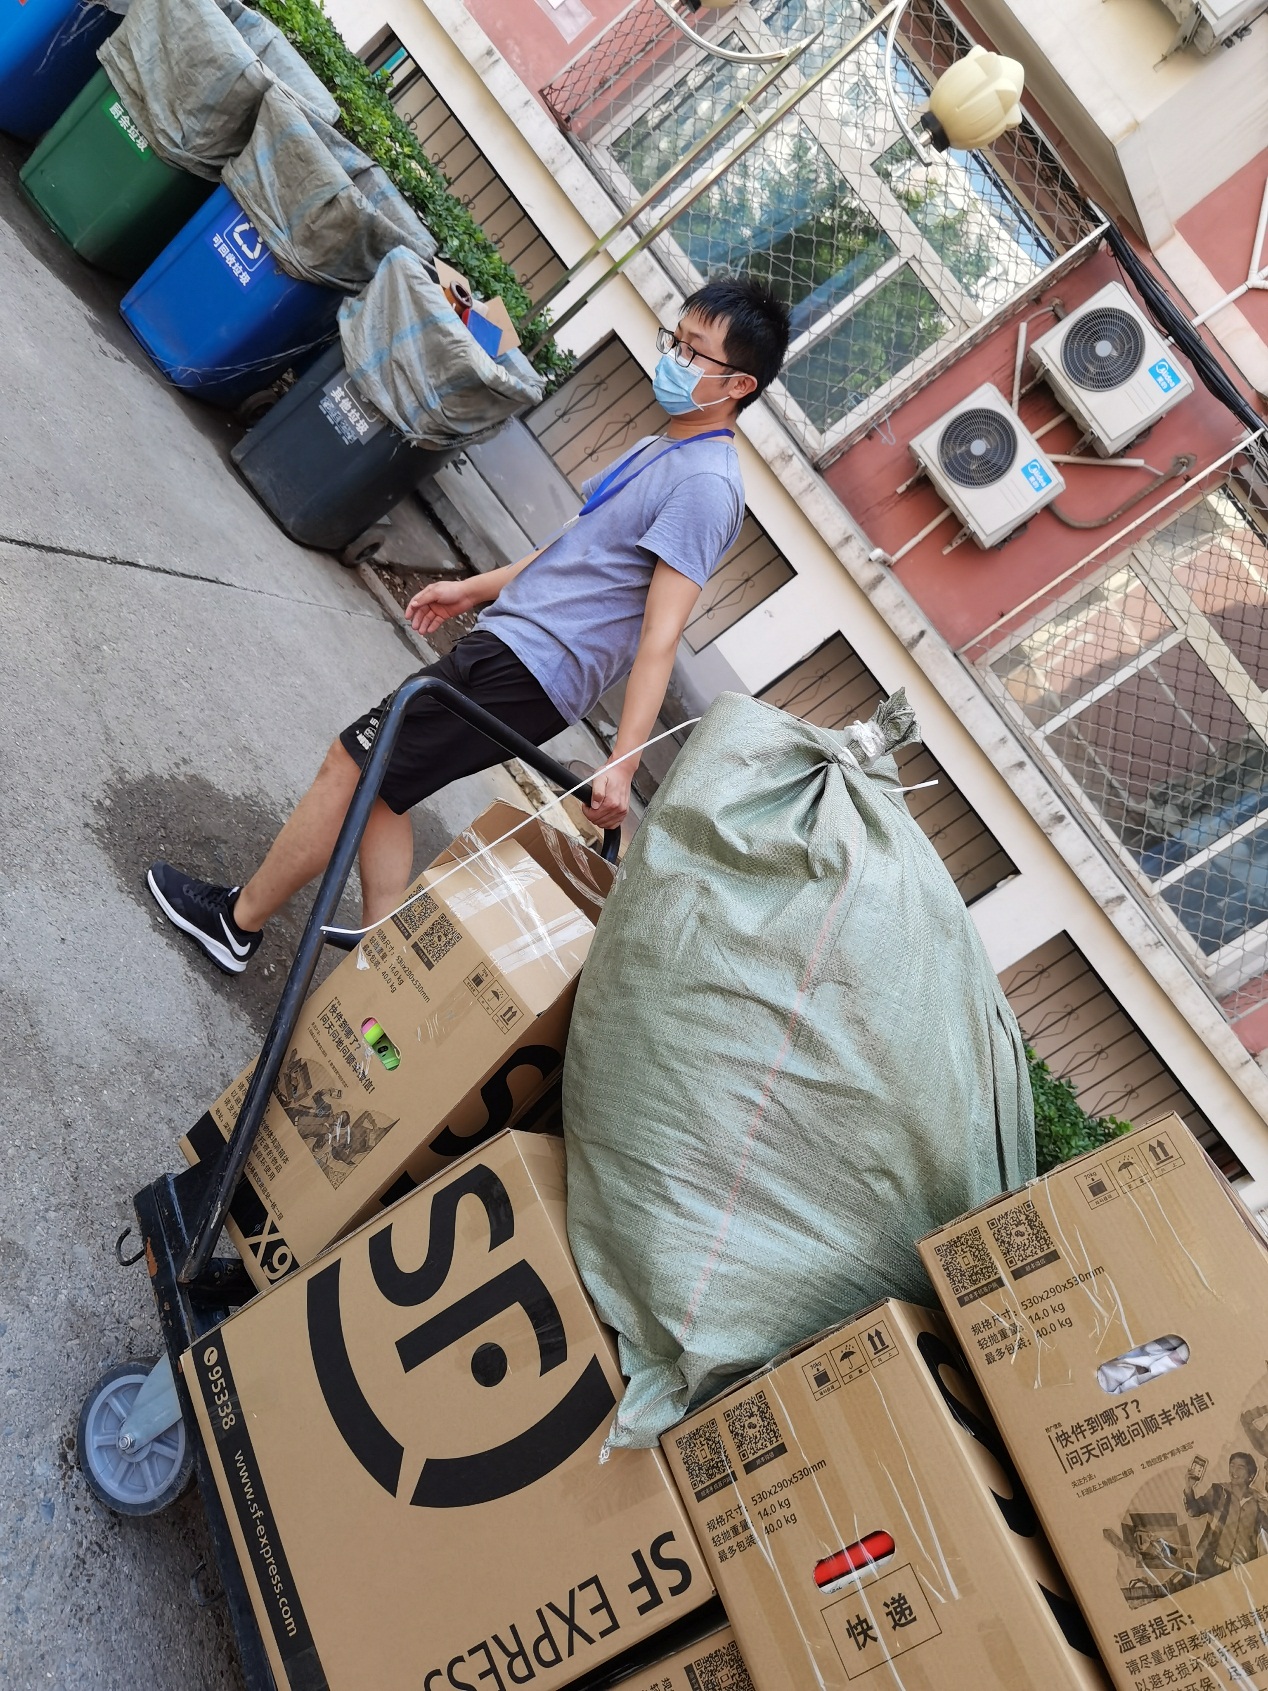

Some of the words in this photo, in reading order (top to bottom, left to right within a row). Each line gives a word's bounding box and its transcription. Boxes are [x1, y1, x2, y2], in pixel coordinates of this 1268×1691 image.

[212, 233, 251, 286] 可回收垃圾
[330, 386, 369, 435] 其他垃圾
[396, 976, 405, 986] kg
[369, 1163, 568, 1388] SF
[1020, 1265, 1105, 1311] 530x290x530mm
[1028, 1308, 1050, 1325] 14.0
[1050, 1301, 1066, 1315] kg
[1035, 1321, 1057, 1339] 40.0
[1057, 1315, 1073, 1330] kg
[208, 1365, 237, 1430] 95338
[751, 1458, 827, 1506] 530x290x530mm
[757, 1503, 777, 1521] 14.0
[777, 1497, 792, 1511] kg
[233, 1449, 297, 1638] www.sf-express.com
[717, 1534, 757, 1563] 最多包装
[763, 1521, 783, 1537] 40.0
[784, 1512, 798, 1526] kg
[627, 1530, 692, 1617] SF
[845, 1592, 917, 1651] 快递
